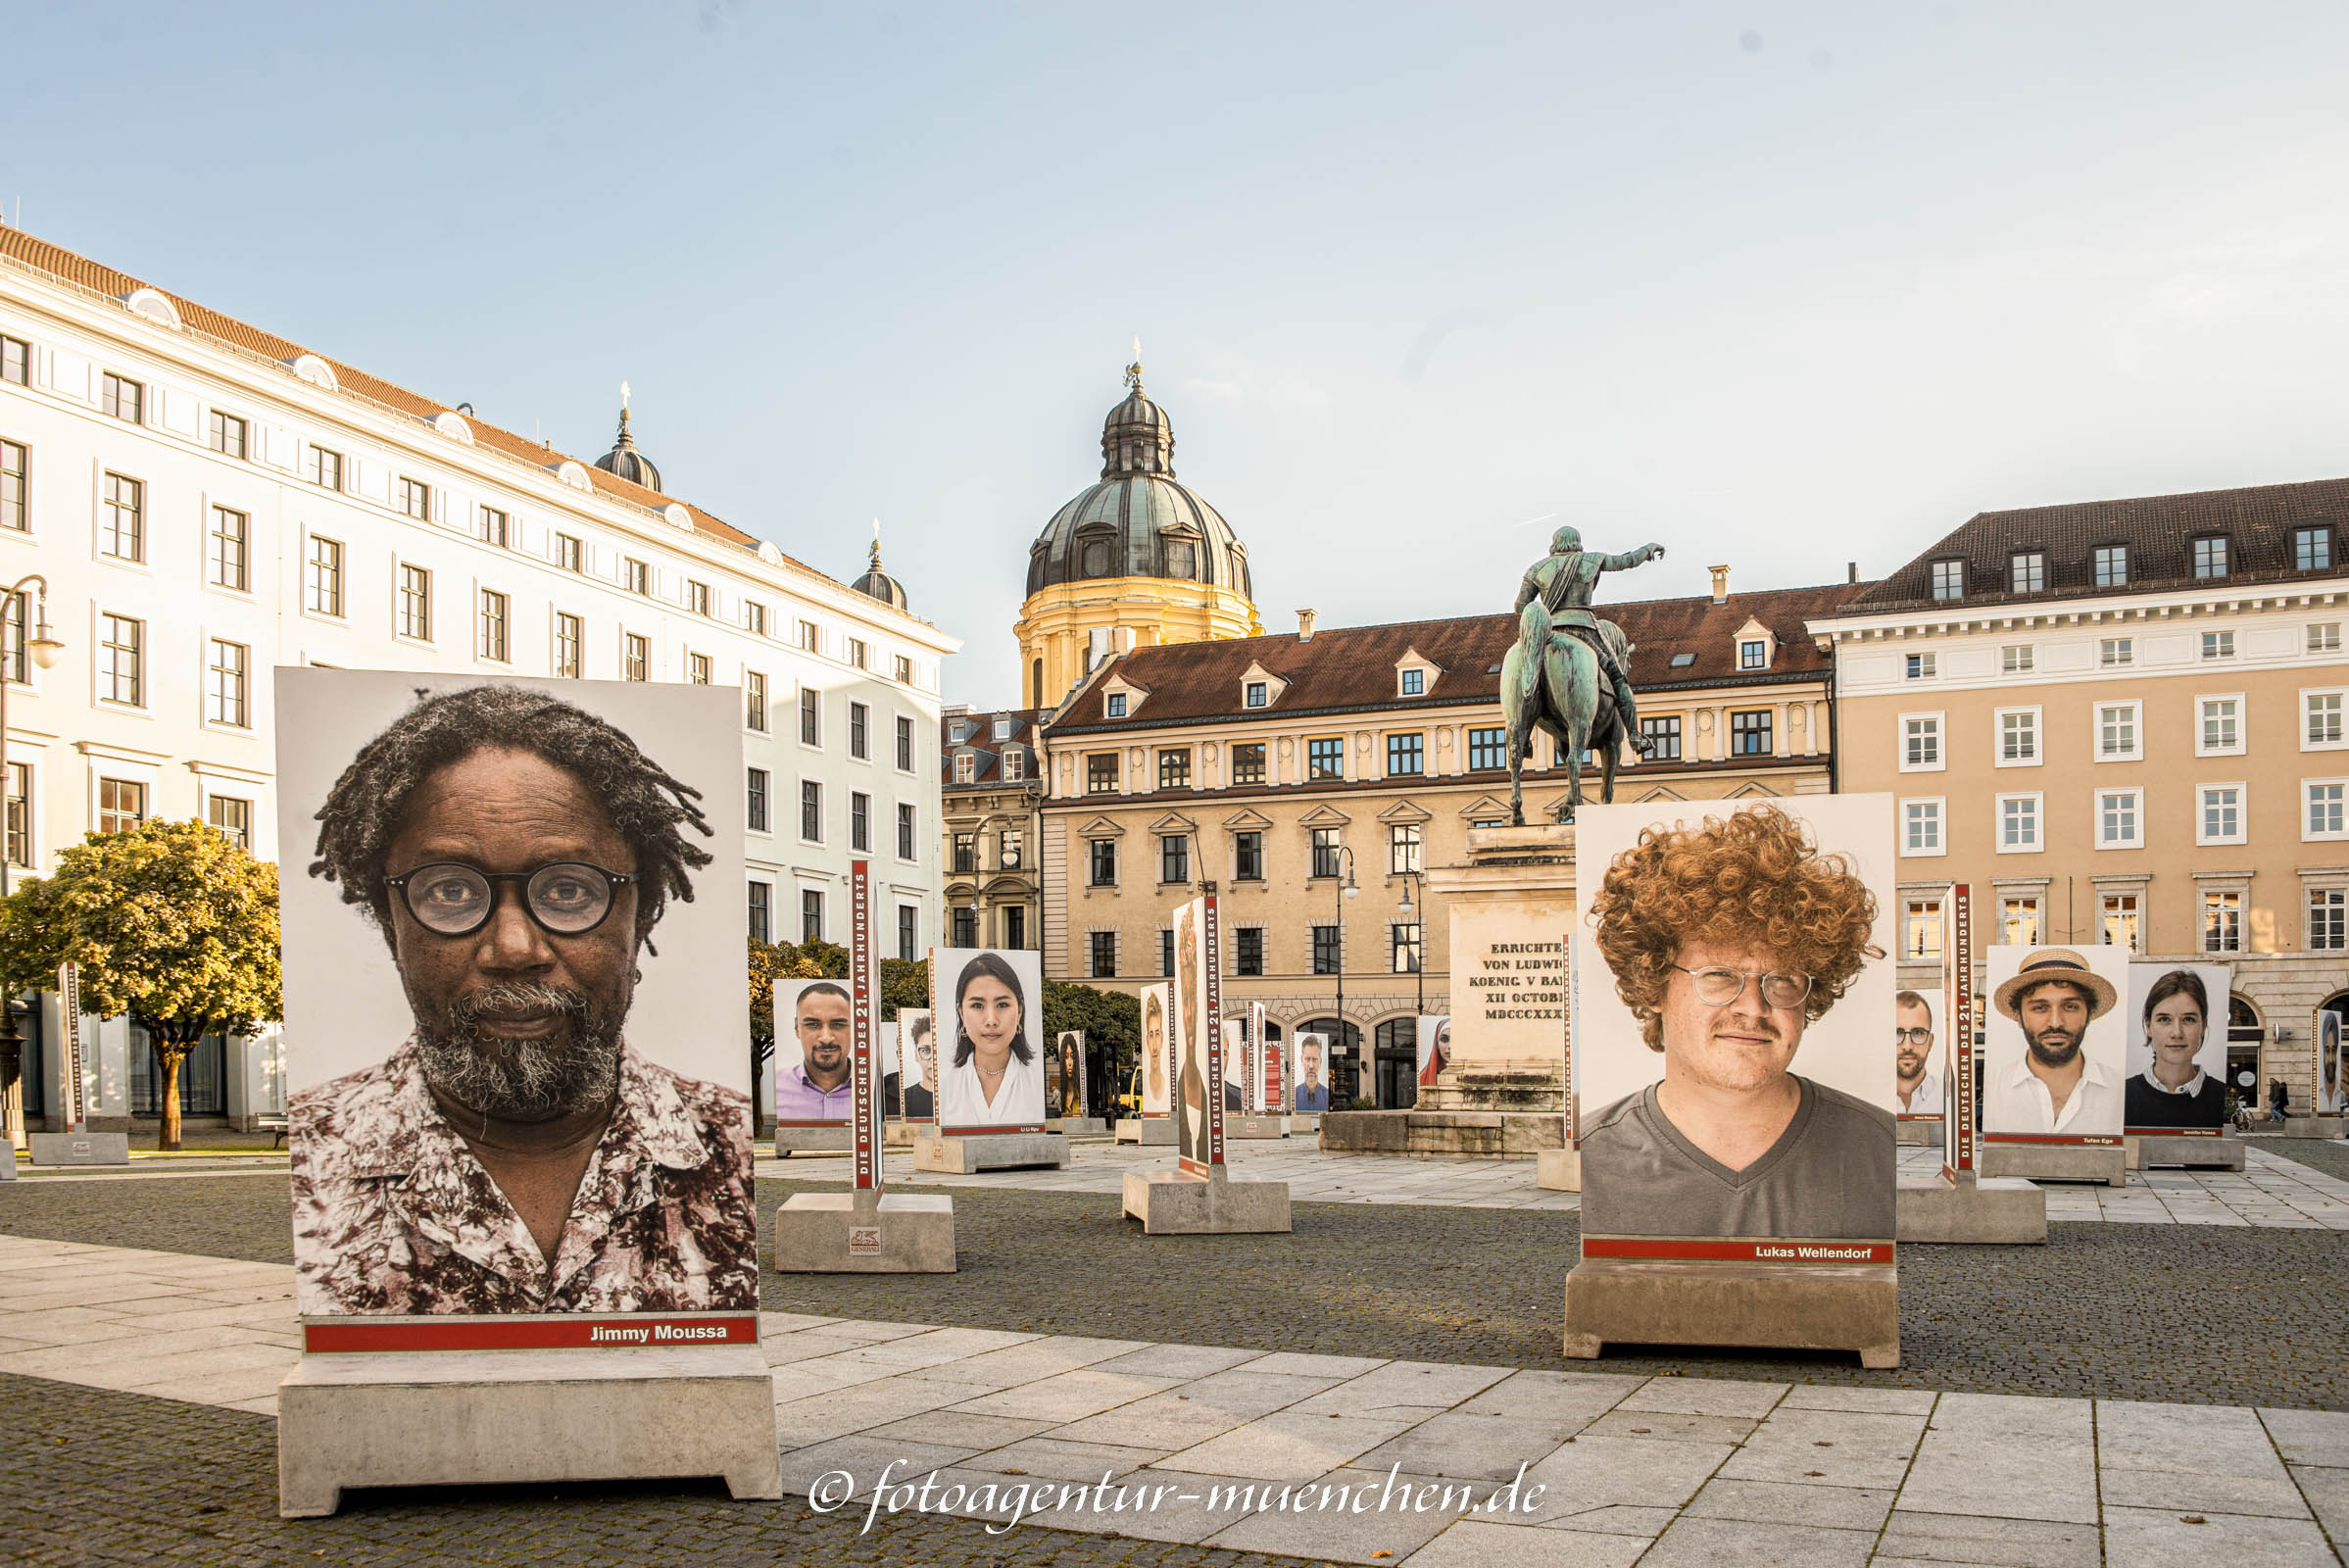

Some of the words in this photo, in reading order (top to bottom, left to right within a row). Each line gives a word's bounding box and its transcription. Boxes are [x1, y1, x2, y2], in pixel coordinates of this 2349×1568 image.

[855, 873, 865, 990] JAHRHUNDERTS
[1207, 907, 1216, 1003] JAHRHUNDERTS
[1958, 896, 1967, 997] JAHRHUNDERTS
[1483, 960, 1510, 970] VON
[1541, 976, 1562, 986] BA
[856, 994, 867, 1017] 21.
[1486, 993, 1506, 1004] XII
[1209, 1005, 1218, 1024] 21.
[1959, 1000, 1969, 1020] 21.
[857, 1021, 866, 1048] DES
[857, 1056, 867, 1143] DEUTSCHEN
[859, 1151, 868, 1174] DIE
[1755, 1246, 1795, 1257] Lukas
[1797, 1247, 1873, 1258] Wellendorf
[590, 1326, 650, 1344] Jimmy
[655, 1325, 727, 1340] Moussa
